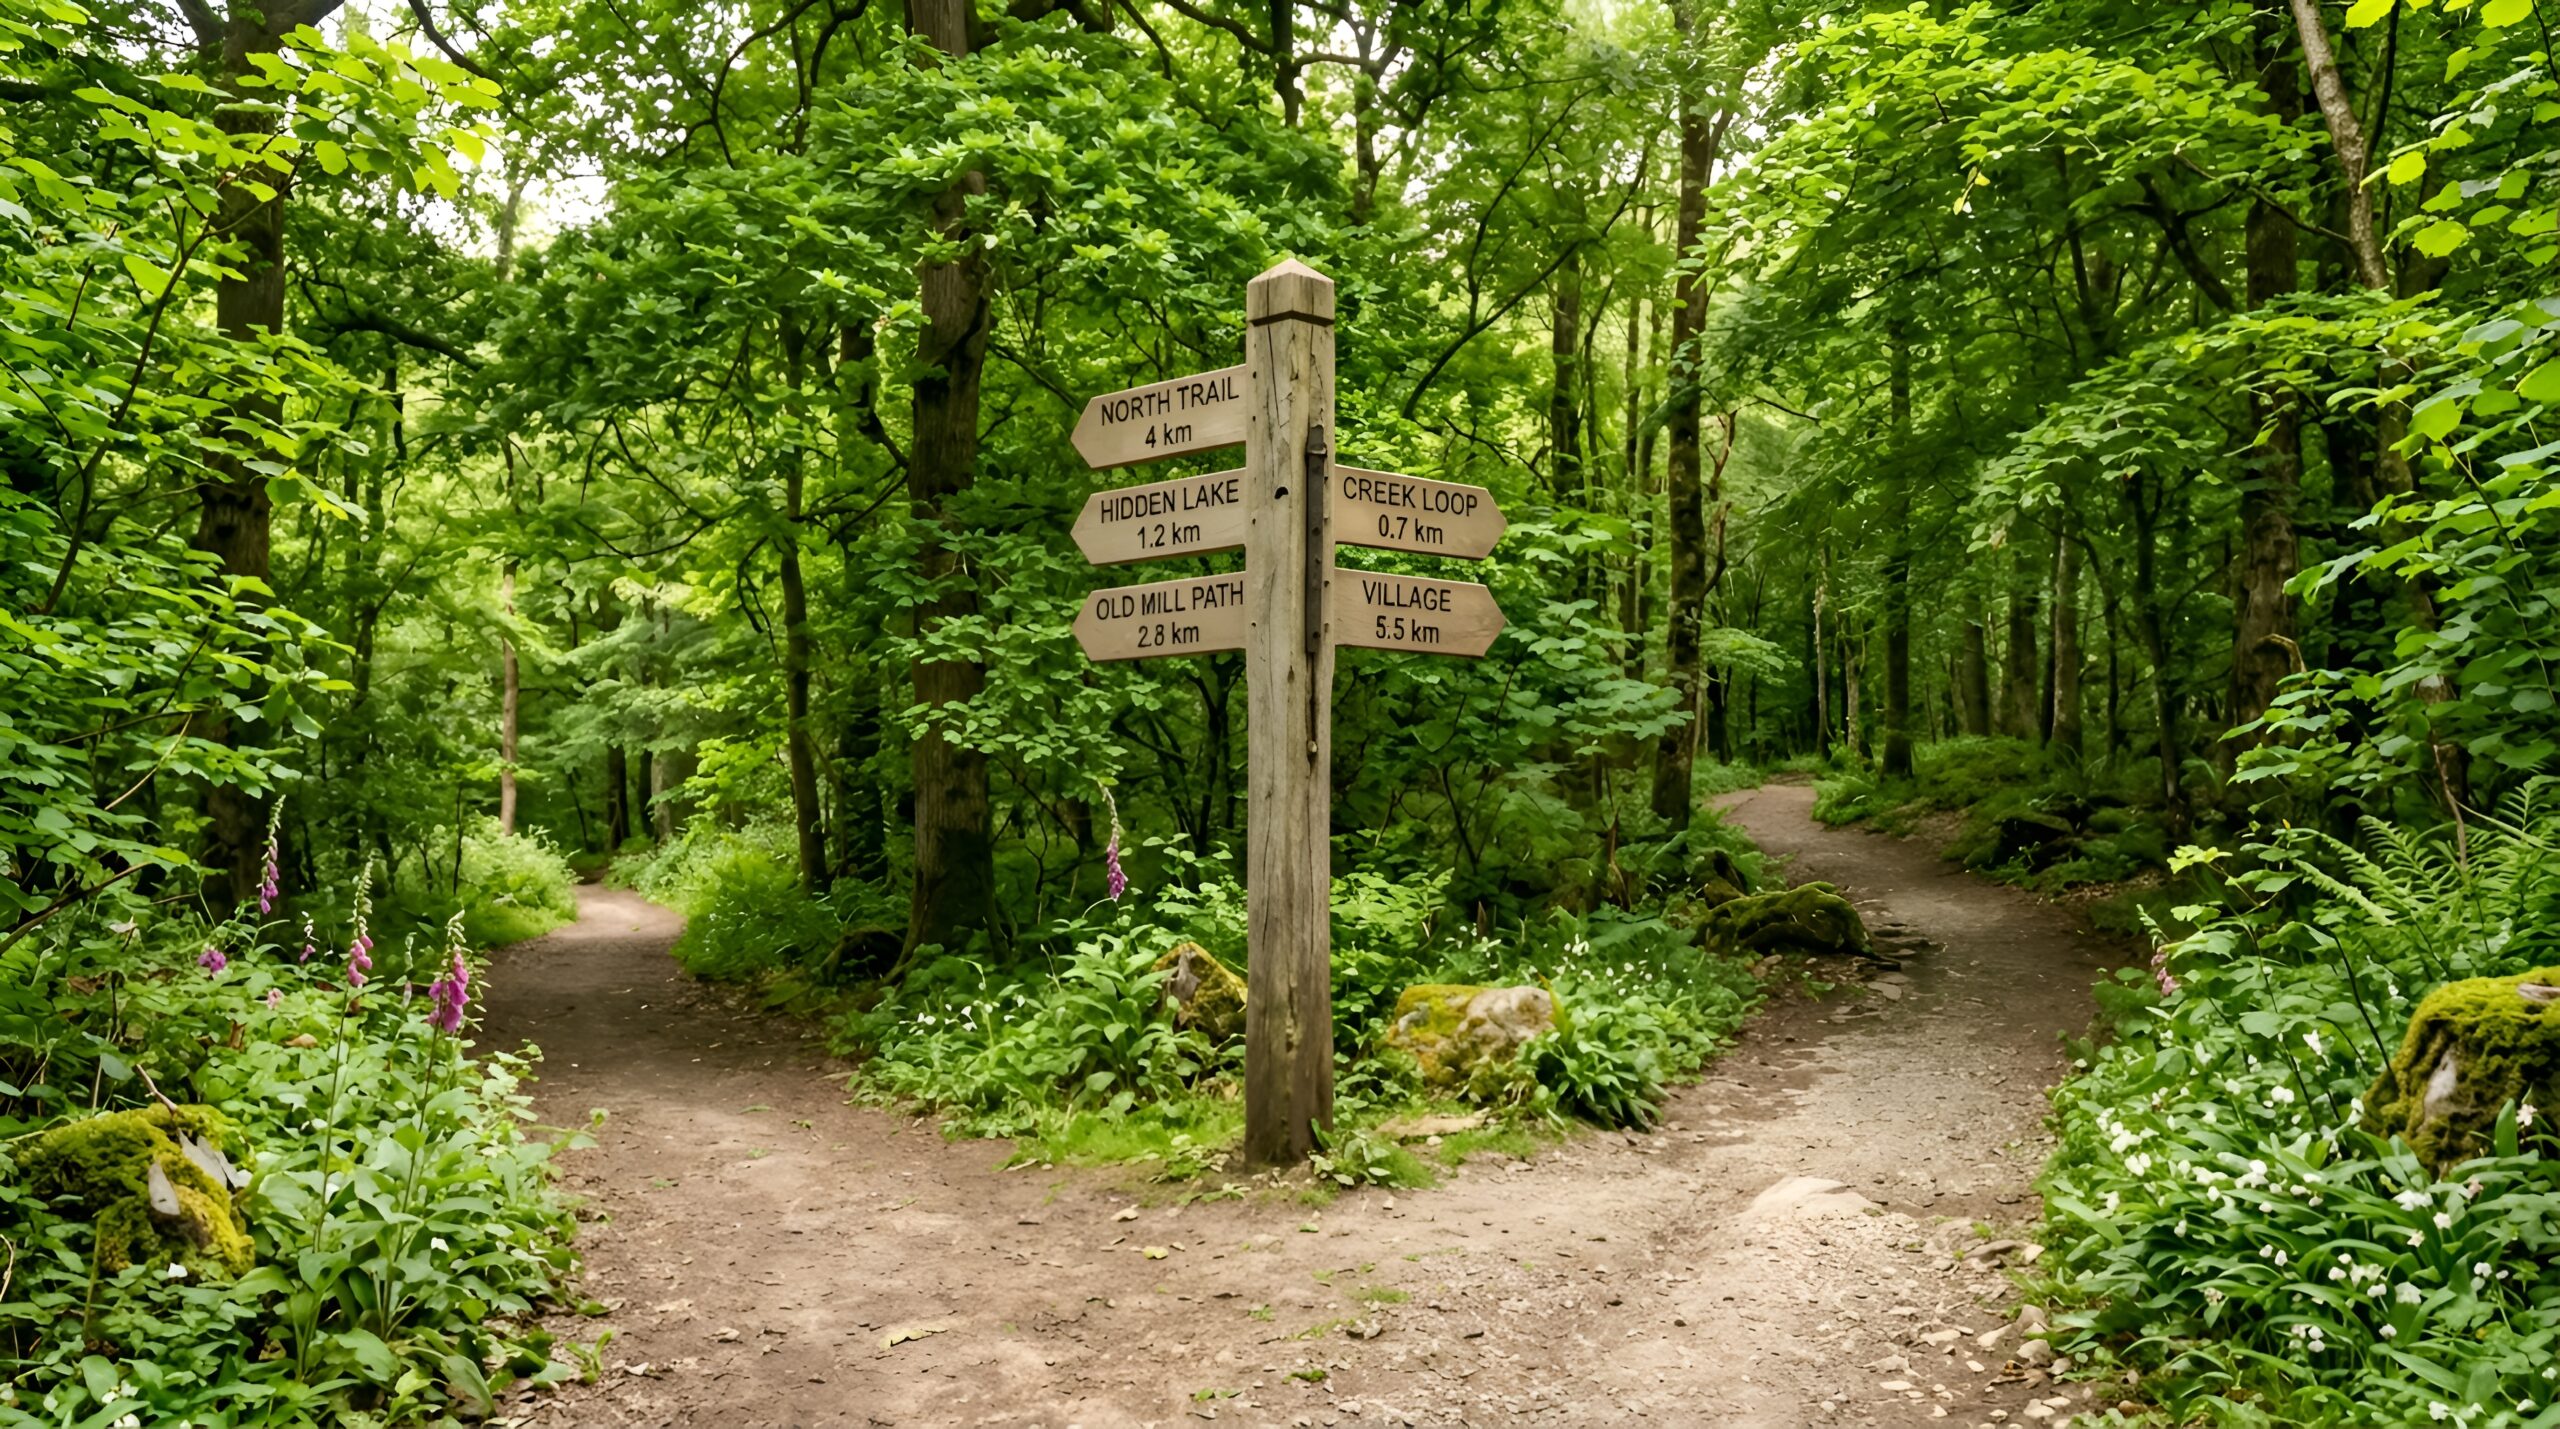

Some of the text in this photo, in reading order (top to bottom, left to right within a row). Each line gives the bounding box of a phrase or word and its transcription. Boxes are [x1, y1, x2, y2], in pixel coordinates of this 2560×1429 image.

[1101, 376, 1239, 426] NORTH TRAIL
[1145, 423, 1192, 448] 4 km
[1101, 478, 1239, 524] HIDDEN LAKE
[1343, 476, 1478, 517] CREEK LOOP
[1137, 522, 1200, 549] 1.2 km
[1378, 514, 1443, 545] 0.7 km
[1096, 580, 1244, 620] OLD MILL PATH
[1362, 580, 1452, 612] VILLAGE
[1172, 621, 1199, 645] km
[1411, 619, 1439, 643] km
